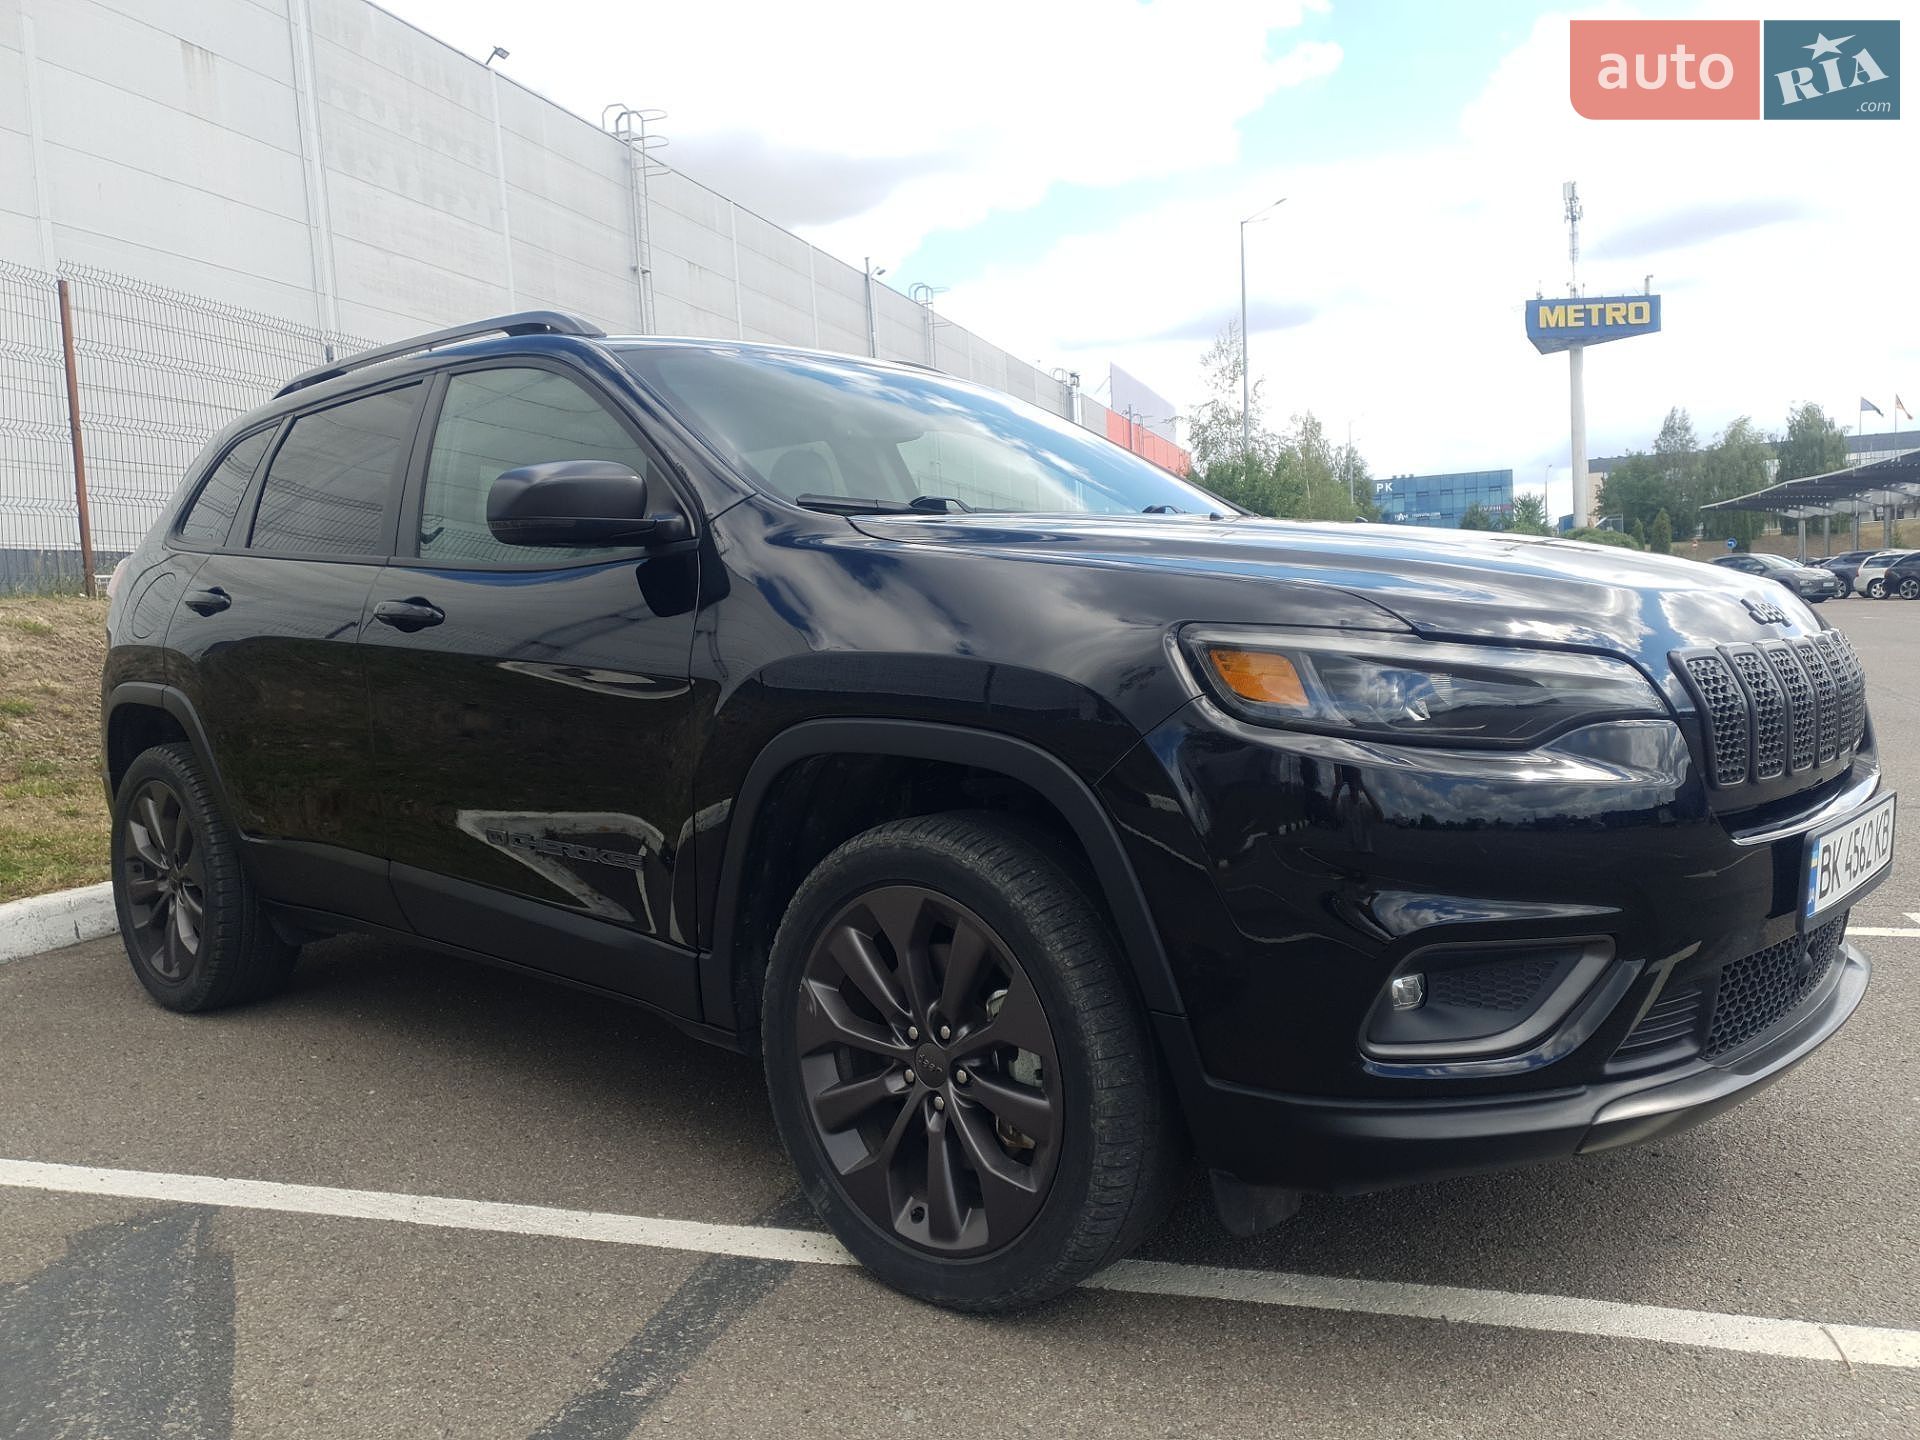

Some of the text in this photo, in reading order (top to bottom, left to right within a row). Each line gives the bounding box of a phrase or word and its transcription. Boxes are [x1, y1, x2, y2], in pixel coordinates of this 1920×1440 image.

[1539, 301, 1650, 328] METRO
[1819, 809, 1890, 899] BK 4562 KB
